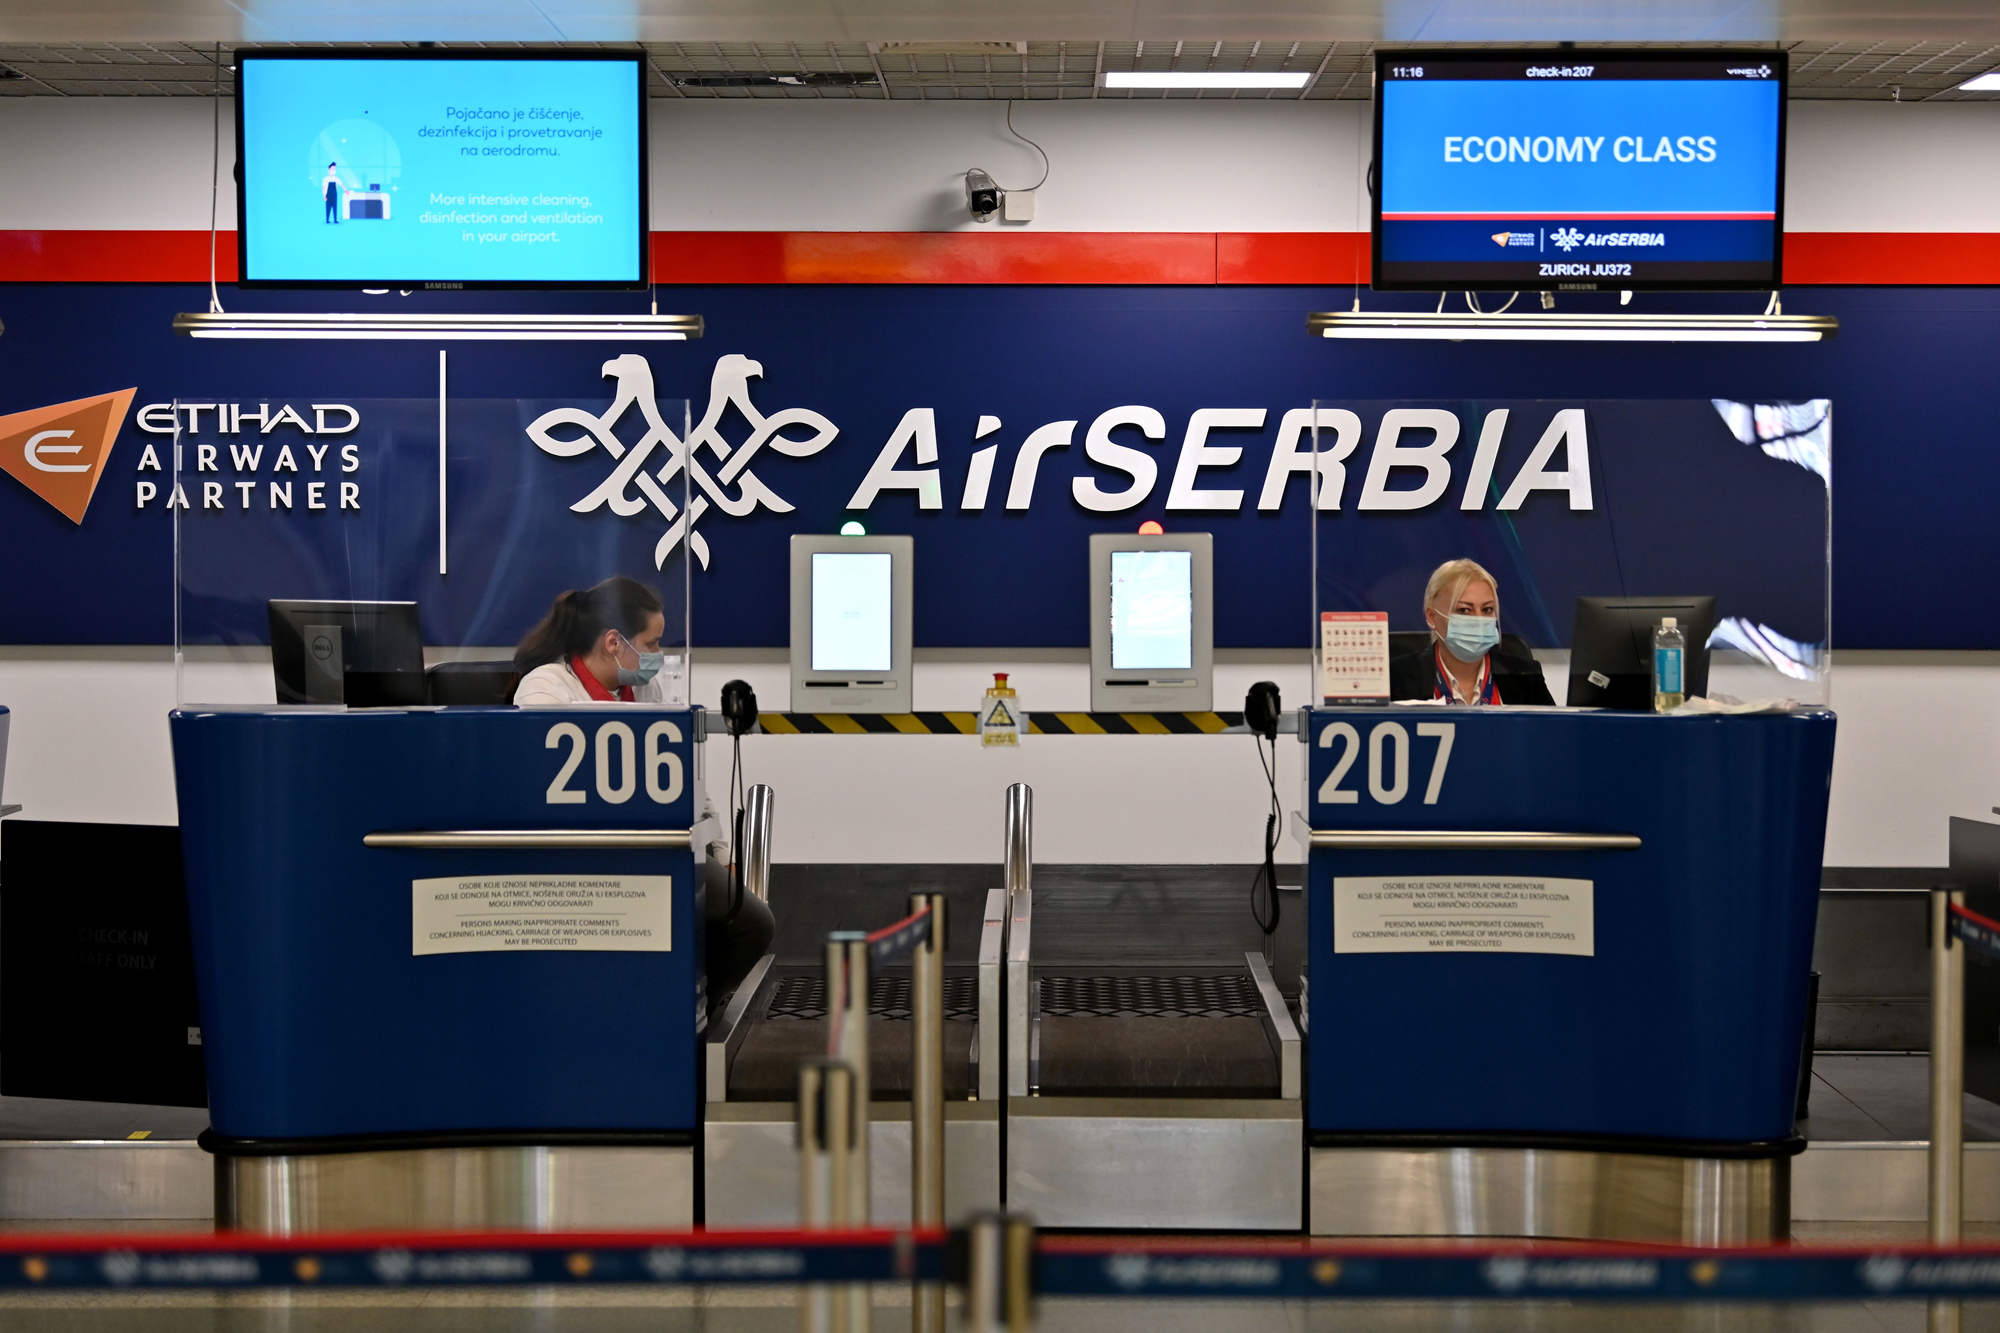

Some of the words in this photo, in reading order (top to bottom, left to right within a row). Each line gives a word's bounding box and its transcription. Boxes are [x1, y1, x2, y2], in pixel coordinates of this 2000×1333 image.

[1392, 66, 1424, 78] 11:16
[1526, 66, 1571, 78] check-in
[1572, 66, 1595, 78] 207
[446, 106, 510, 123] Pojačano
[512, 108, 525, 123] je
[528, 107, 584, 123] čišćenje,
[418, 125, 497, 141] dezinfekcija
[508, 126, 603, 141] provetravanje
[461, 147, 478, 156] na
[482, 144, 561, 156] aerodromu.
[1444, 136, 1605, 163] ECONOMY
[1613, 136, 1717, 163] CLASS
[430, 193, 465, 205] More
[468, 193, 529, 205] intensive
[532, 193, 592, 209] cleaning,
[419, 211, 497, 223] disinfection
[500, 211, 527, 223] and
[531, 211, 603, 223] ventilation
[462, 230, 474, 242] in
[478, 232, 508, 244] your
[511, 230, 561, 244] airport.
[1584, 233, 1665, 246] AirSERBIA
[1539, 263, 1589, 276] ZURICH
[1592, 263, 1632, 276] JU372
[136, 403, 360, 434] ETIHAD
[137, 444, 360, 472] AIRWAYS
[845, 405, 1594, 512] AirSERBIA
[136, 481, 361, 509] PARTNER
[545, 720, 684, 804] 206
[1318, 721, 1456, 805] 207
[533, 890, 564, 898] NOŠENJE
[566, 890, 594, 898] ORUŽJA
[1529, 893, 1570, 901] EKSPLOZIVA
[513, 899, 546, 907] KRIVIČNO
[78, 927, 148, 945] CHECK-IN
[430, 931, 475, 939] CONCERNING
[611, 929, 652, 937] EXPLOSIVES
[1536, 932, 1576, 940] EXPLOSIVES
[117, 954, 157, 970] ONLY
